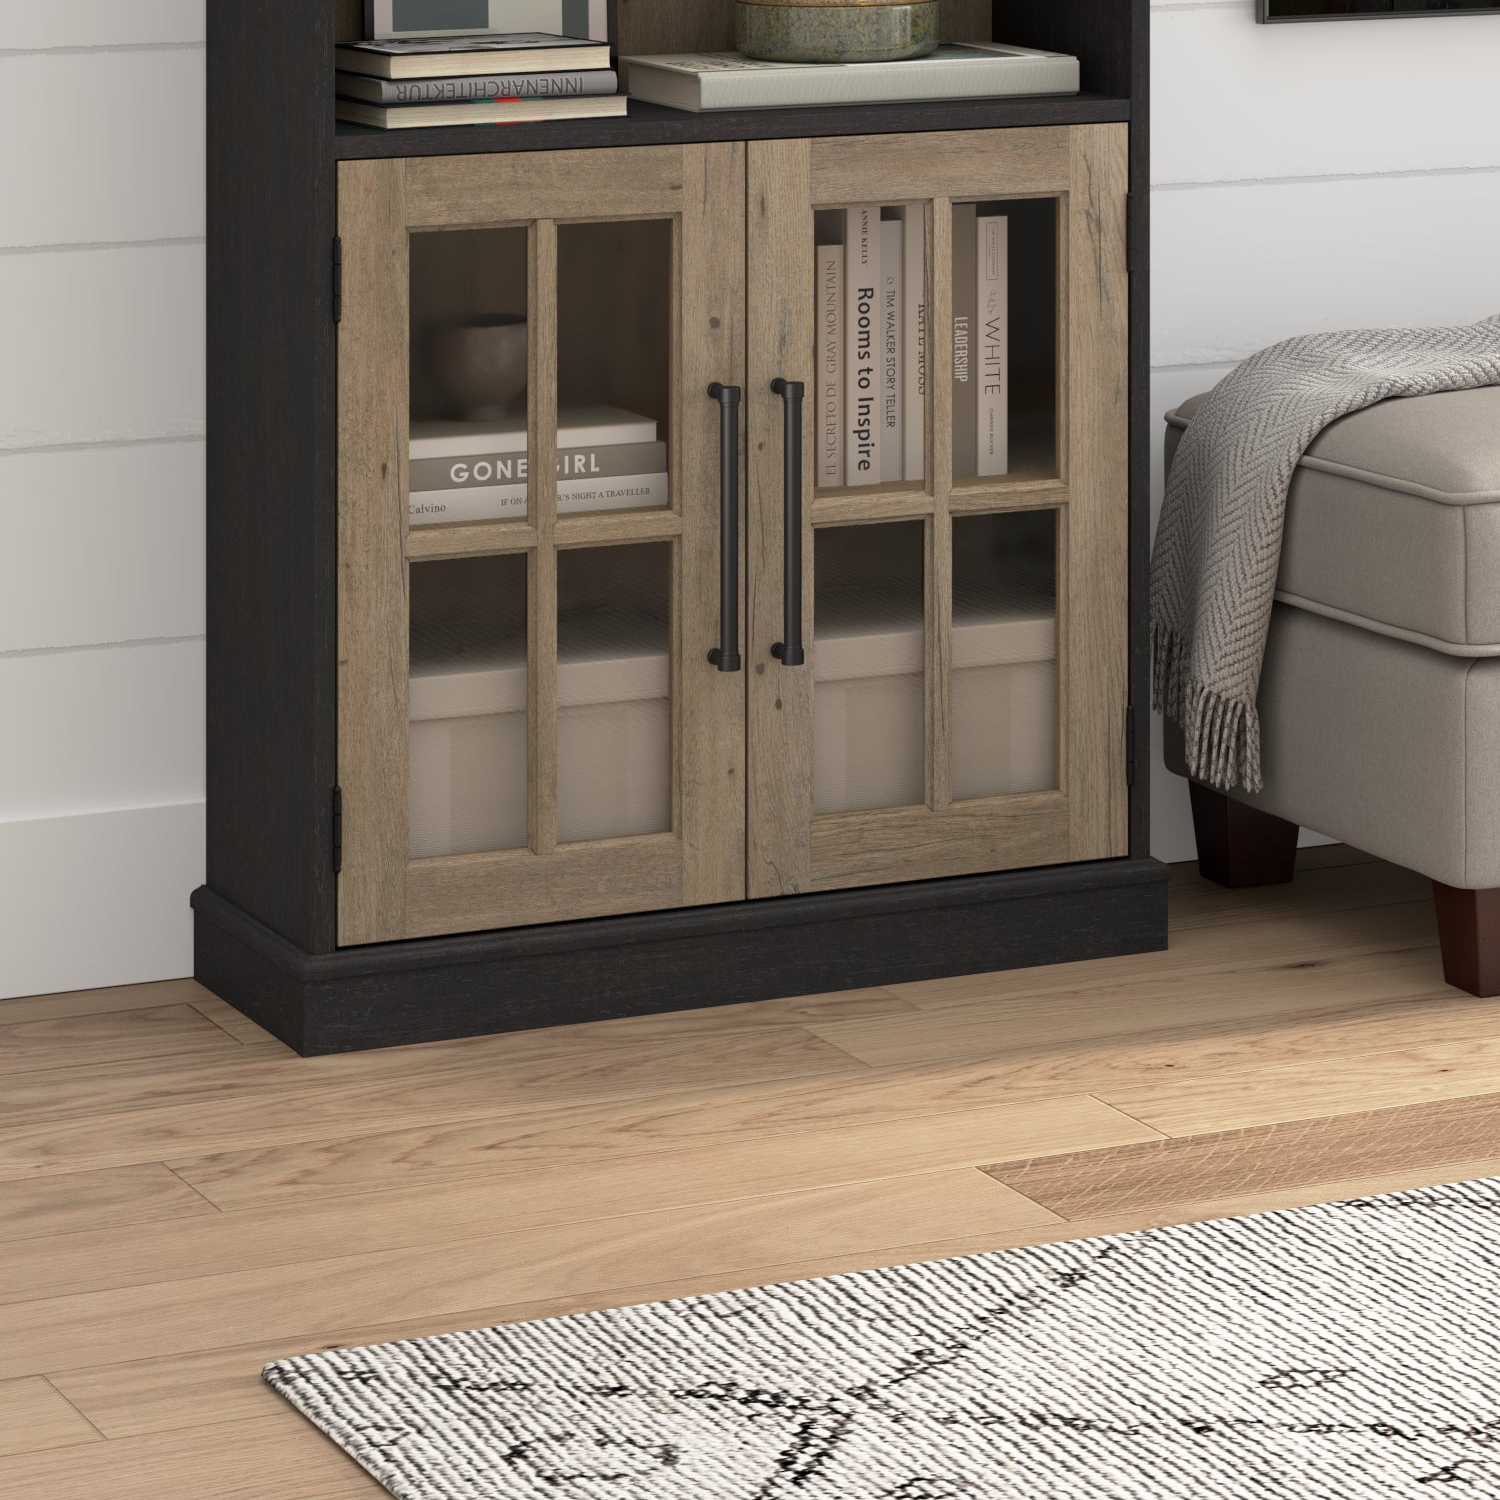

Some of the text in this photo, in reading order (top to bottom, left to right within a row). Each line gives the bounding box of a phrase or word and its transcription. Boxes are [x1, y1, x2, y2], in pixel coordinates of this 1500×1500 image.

[396, 77, 584, 101] INNENARCHITEKTUR
[826, 260, 837, 475] EL SECRETO DE GRAY MOUNTAIN
[886, 290, 896, 428] TIM WALKER STORY TELLER
[954, 316, 968, 382] LEADERSHIP
[984, 317, 1001, 395] WHITE
[852, 287, 876, 471] Rooms to Inspire
[450, 453, 600, 483] GONE IRL
[408, 502, 447, 515] Calvino
[501, 498, 509, 506] IF
[510, 497, 522, 506] ON
[571, 491, 597, 501] NIGHT
[598, 490, 604, 499] A
[605, 486, 651, 498] TRAVELLER
